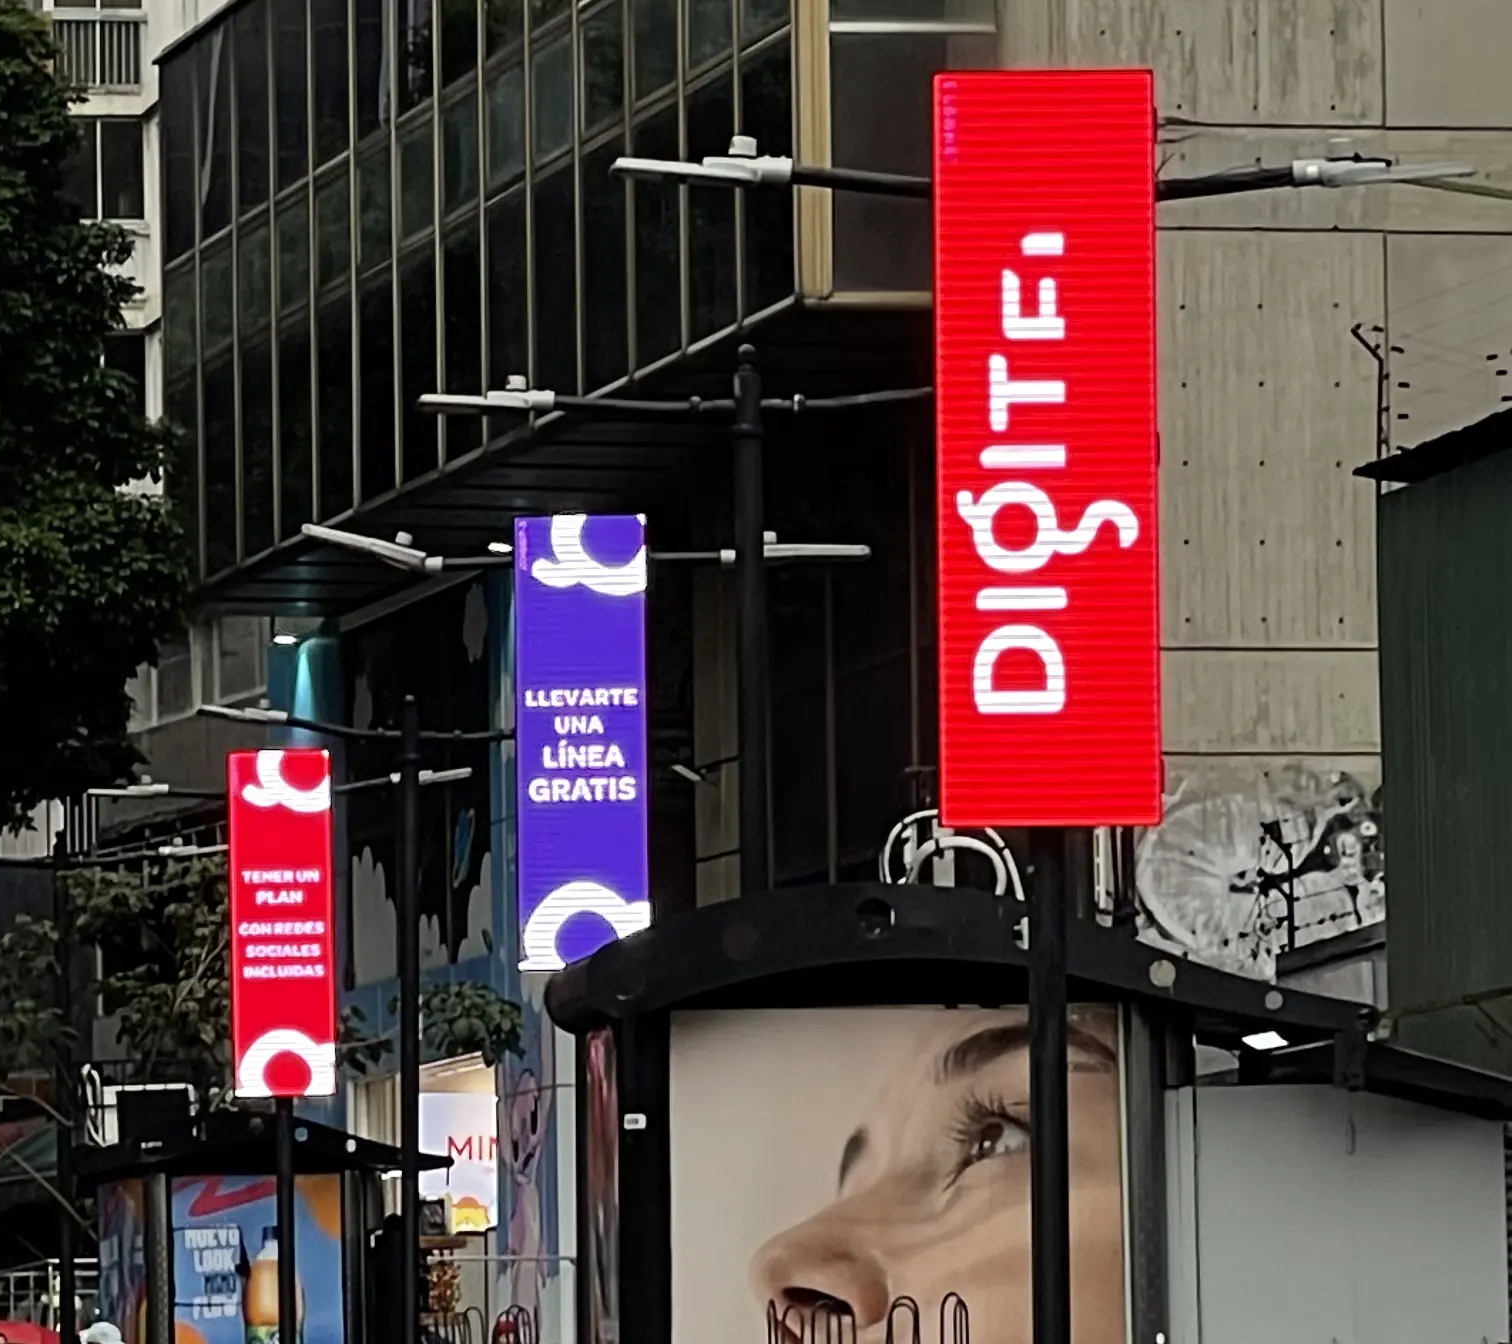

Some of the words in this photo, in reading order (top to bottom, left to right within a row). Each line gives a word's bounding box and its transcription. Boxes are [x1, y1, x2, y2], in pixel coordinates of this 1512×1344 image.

[525, 687, 639, 708] LLEVARTE
[554, 715, 605, 735] UNA
[543, 739, 626, 769] LÍNEA
[529, 776, 637, 803] GRATIS
[242, 869, 294, 884] TENER
[295, 868, 320, 883] UN
[255, 889, 304, 905] PLAN
[239, 922, 272, 937] CON
[274, 920, 326, 936] REDES
[245, 943, 322, 958] SOCIALES
[243, 963, 325, 979] INCLUIDAS
